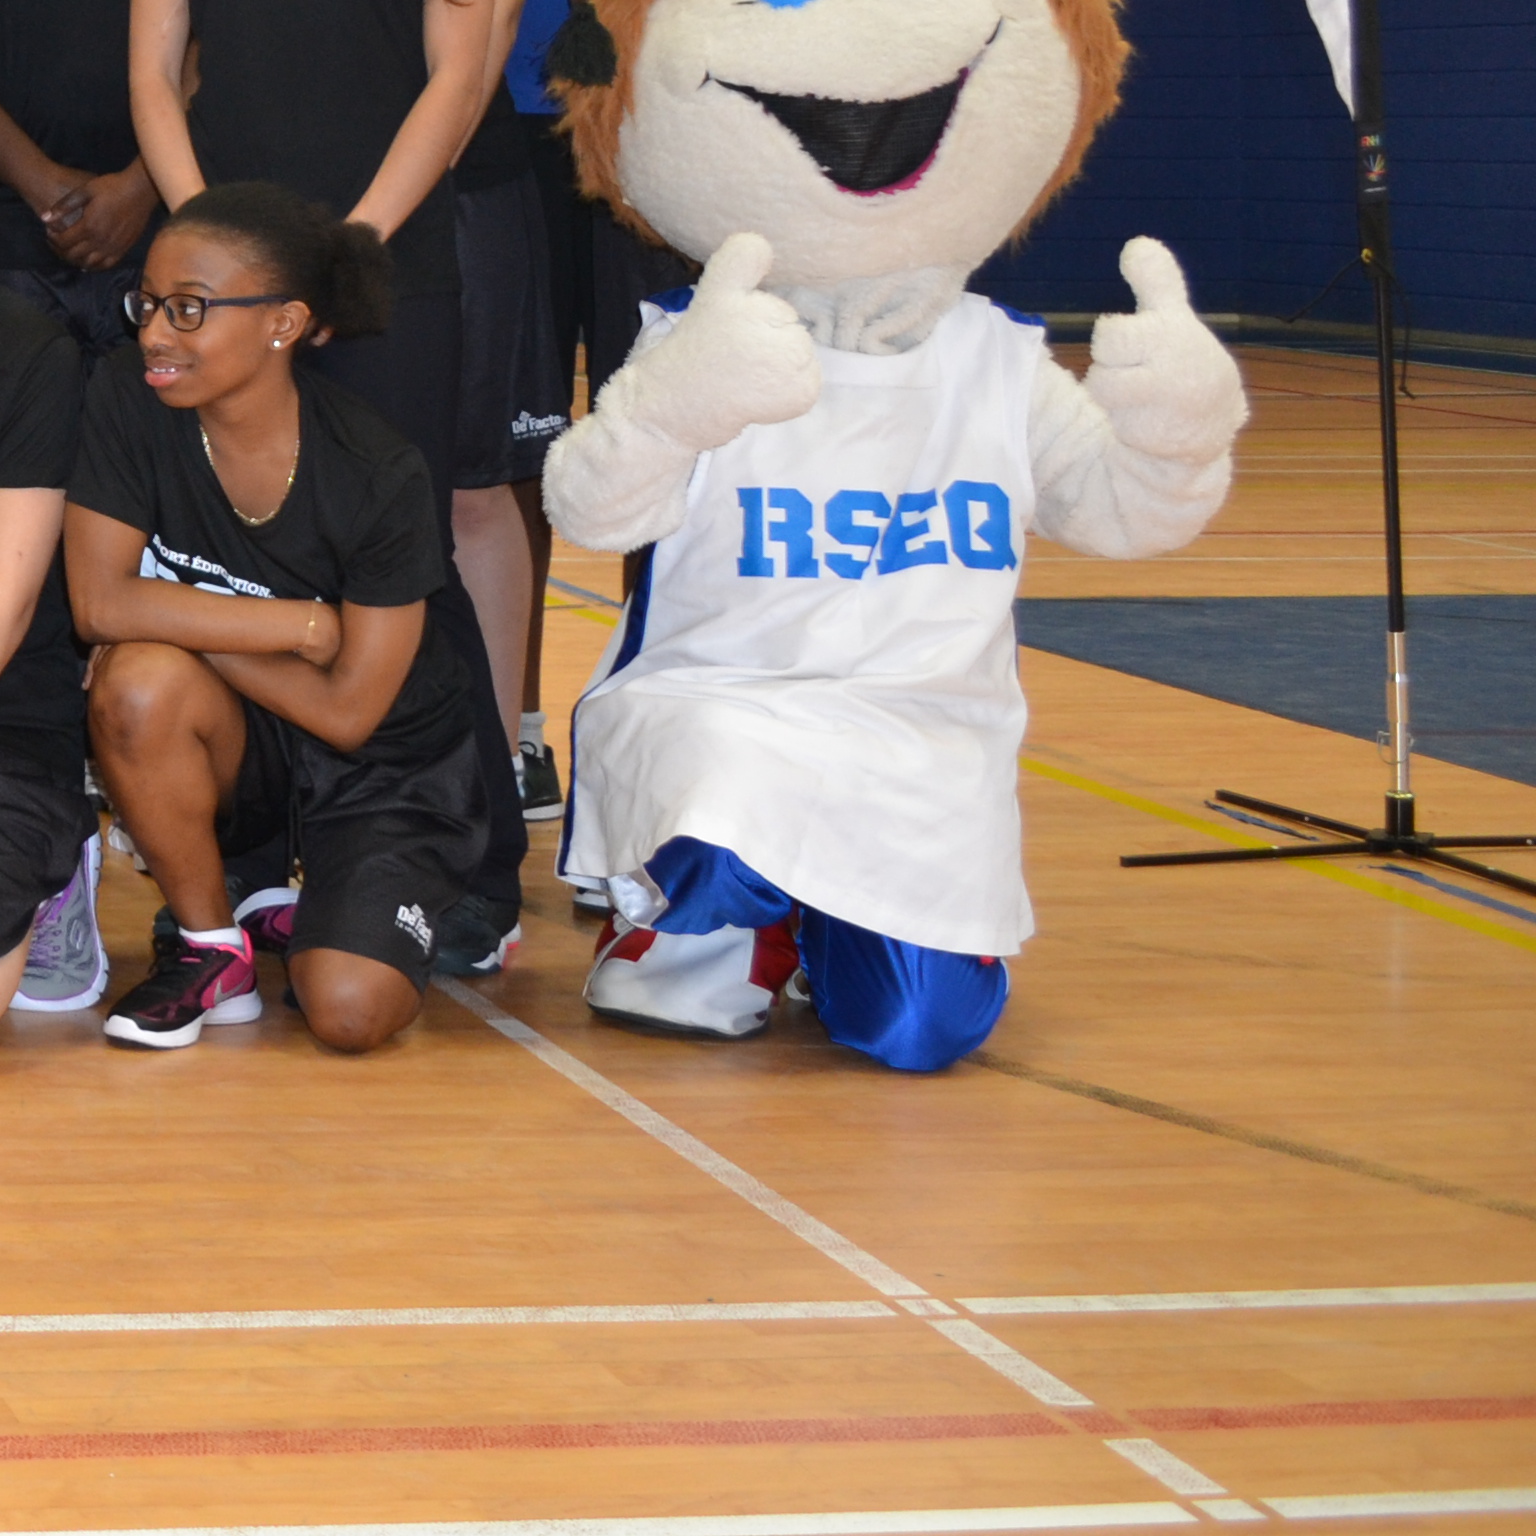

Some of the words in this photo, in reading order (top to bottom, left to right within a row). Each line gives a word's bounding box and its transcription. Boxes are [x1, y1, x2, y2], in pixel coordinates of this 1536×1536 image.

[512, 420, 527, 434] De
[529, 414, 562, 430] Facto
[736, 480, 1018, 580] RSEQ
[152, 533, 190, 567] SORT.
[397, 905, 416, 927] De
